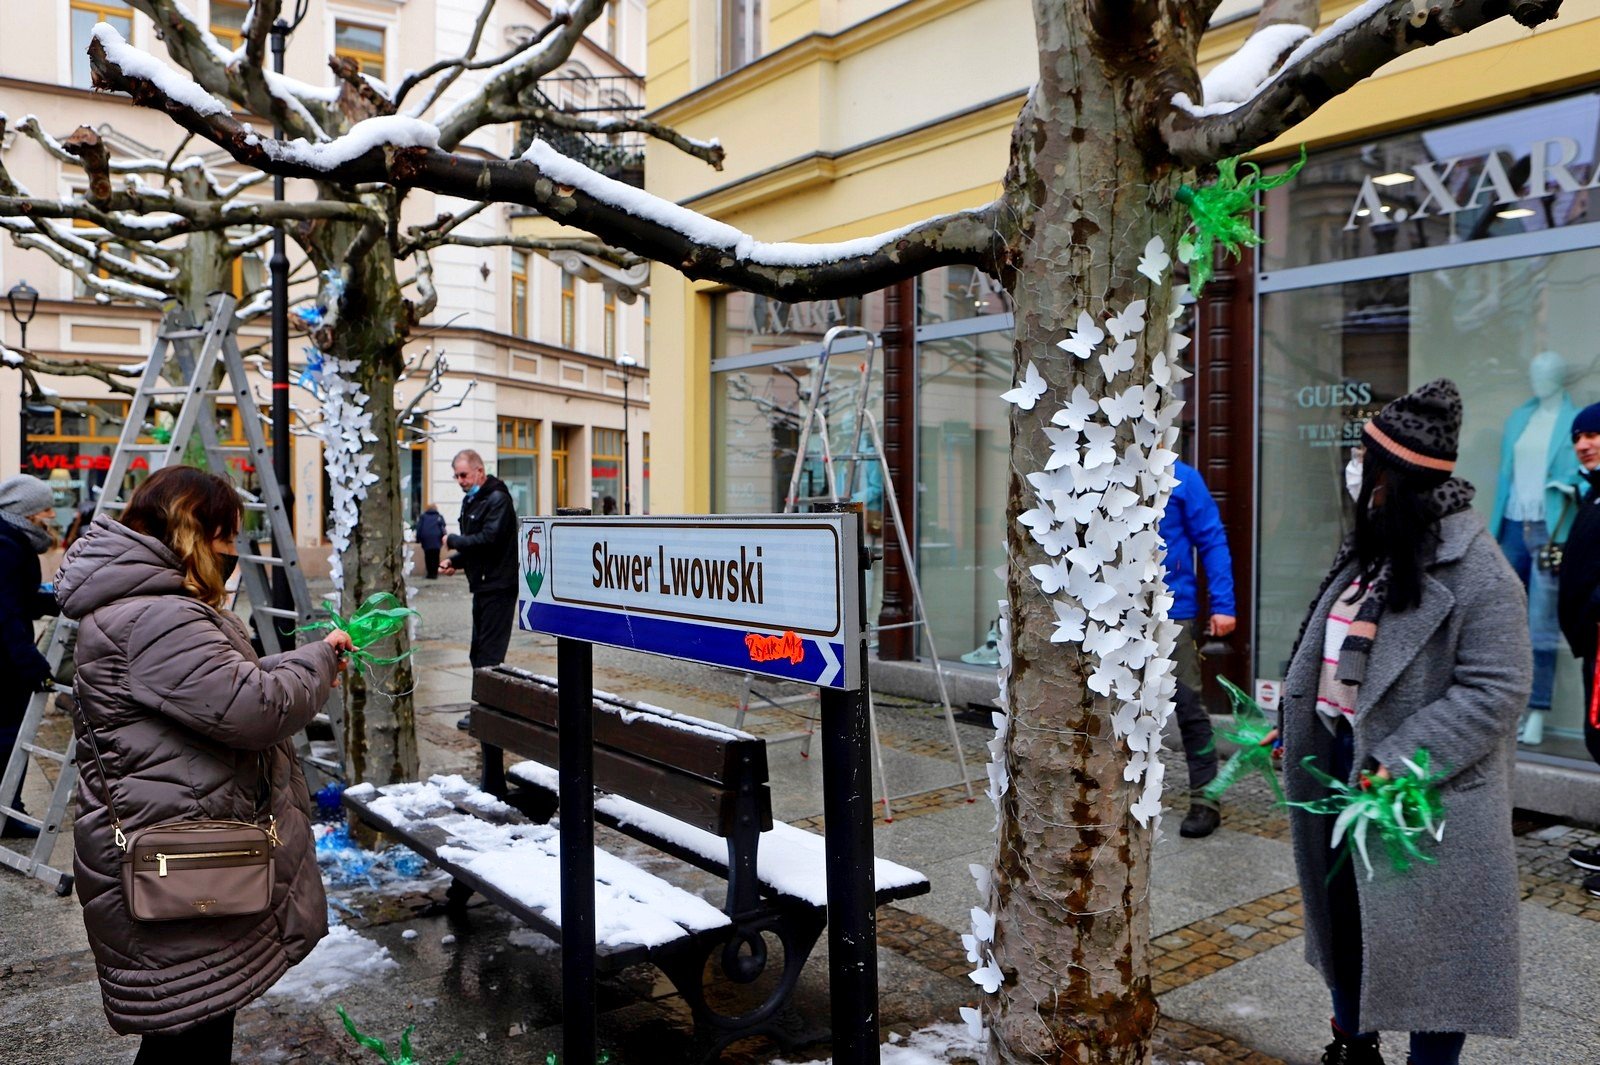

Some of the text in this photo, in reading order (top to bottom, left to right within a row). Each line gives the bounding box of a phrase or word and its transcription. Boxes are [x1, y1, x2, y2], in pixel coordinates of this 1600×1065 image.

[1344, 136, 1600, 231] A.XAR
[1297, 383, 1371, 408] GUESS
[592, 541, 763, 604] Skwer Lwowski
